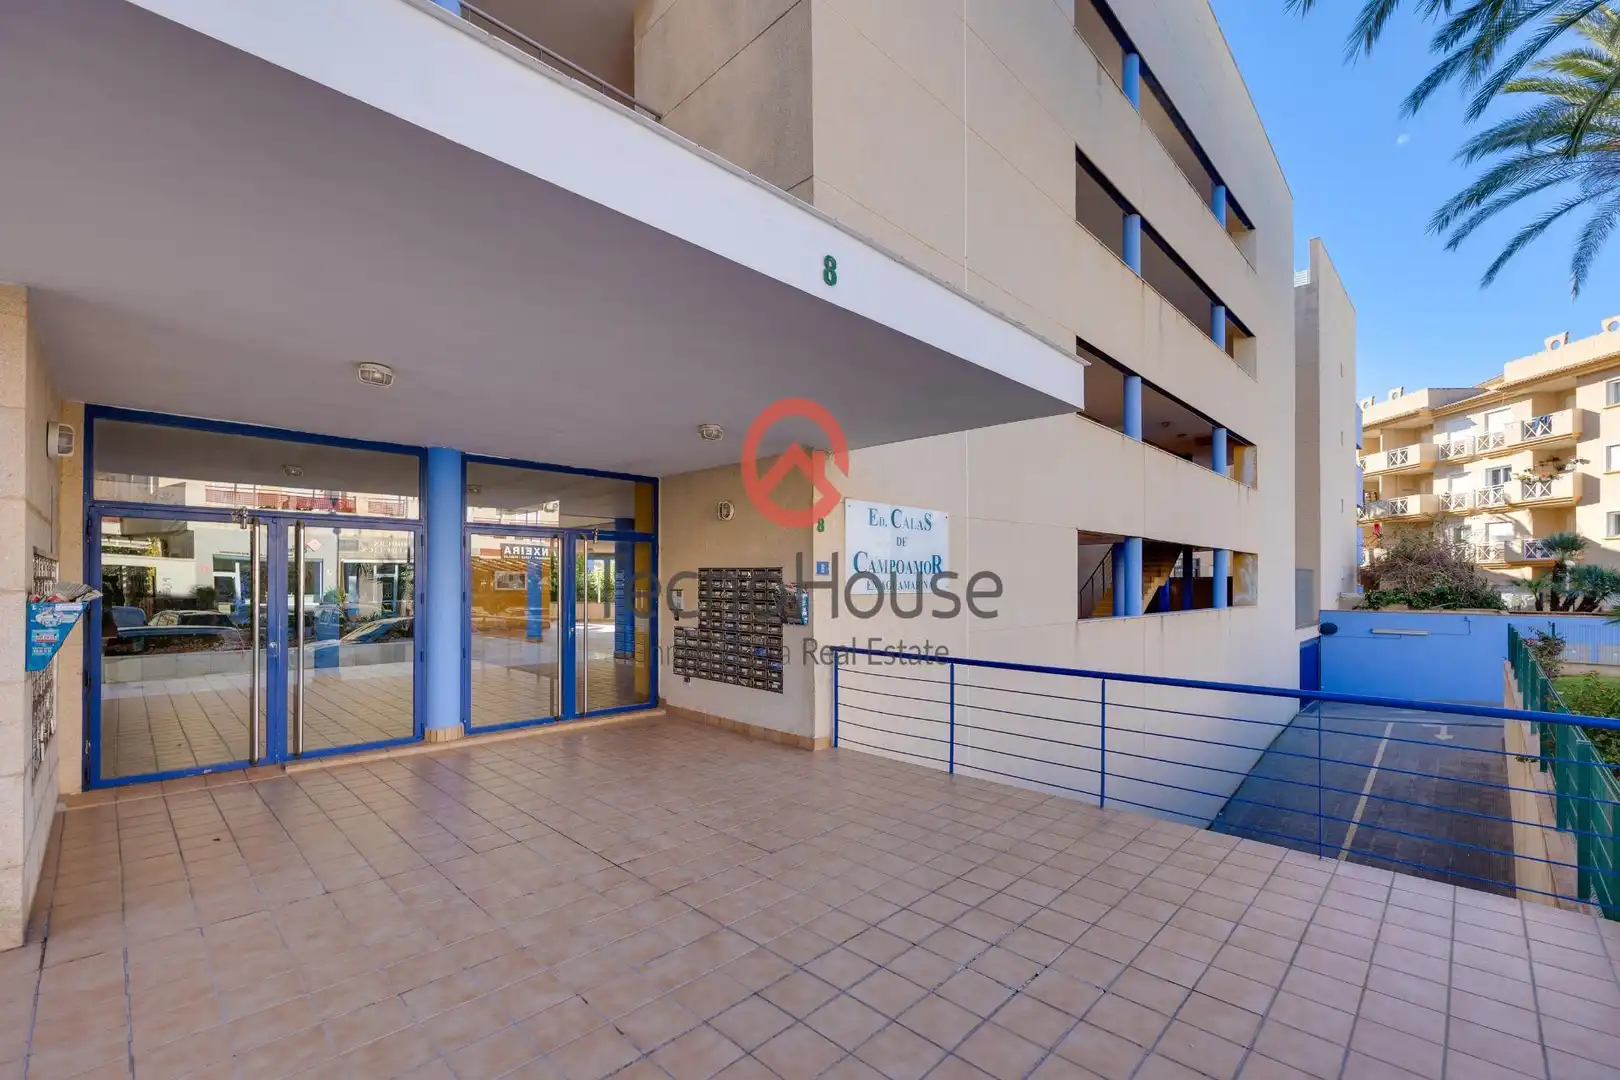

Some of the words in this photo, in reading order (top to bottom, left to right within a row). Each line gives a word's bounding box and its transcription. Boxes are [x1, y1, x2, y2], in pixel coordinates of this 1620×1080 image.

[823, 254, 838, 287] 8
[816, 518, 825, 533] 8
[896, 536, 908, 548] DE
[853, 550, 944, 575] CAMPOAMOR
[880, 578, 936, 592] AGAMARIN
